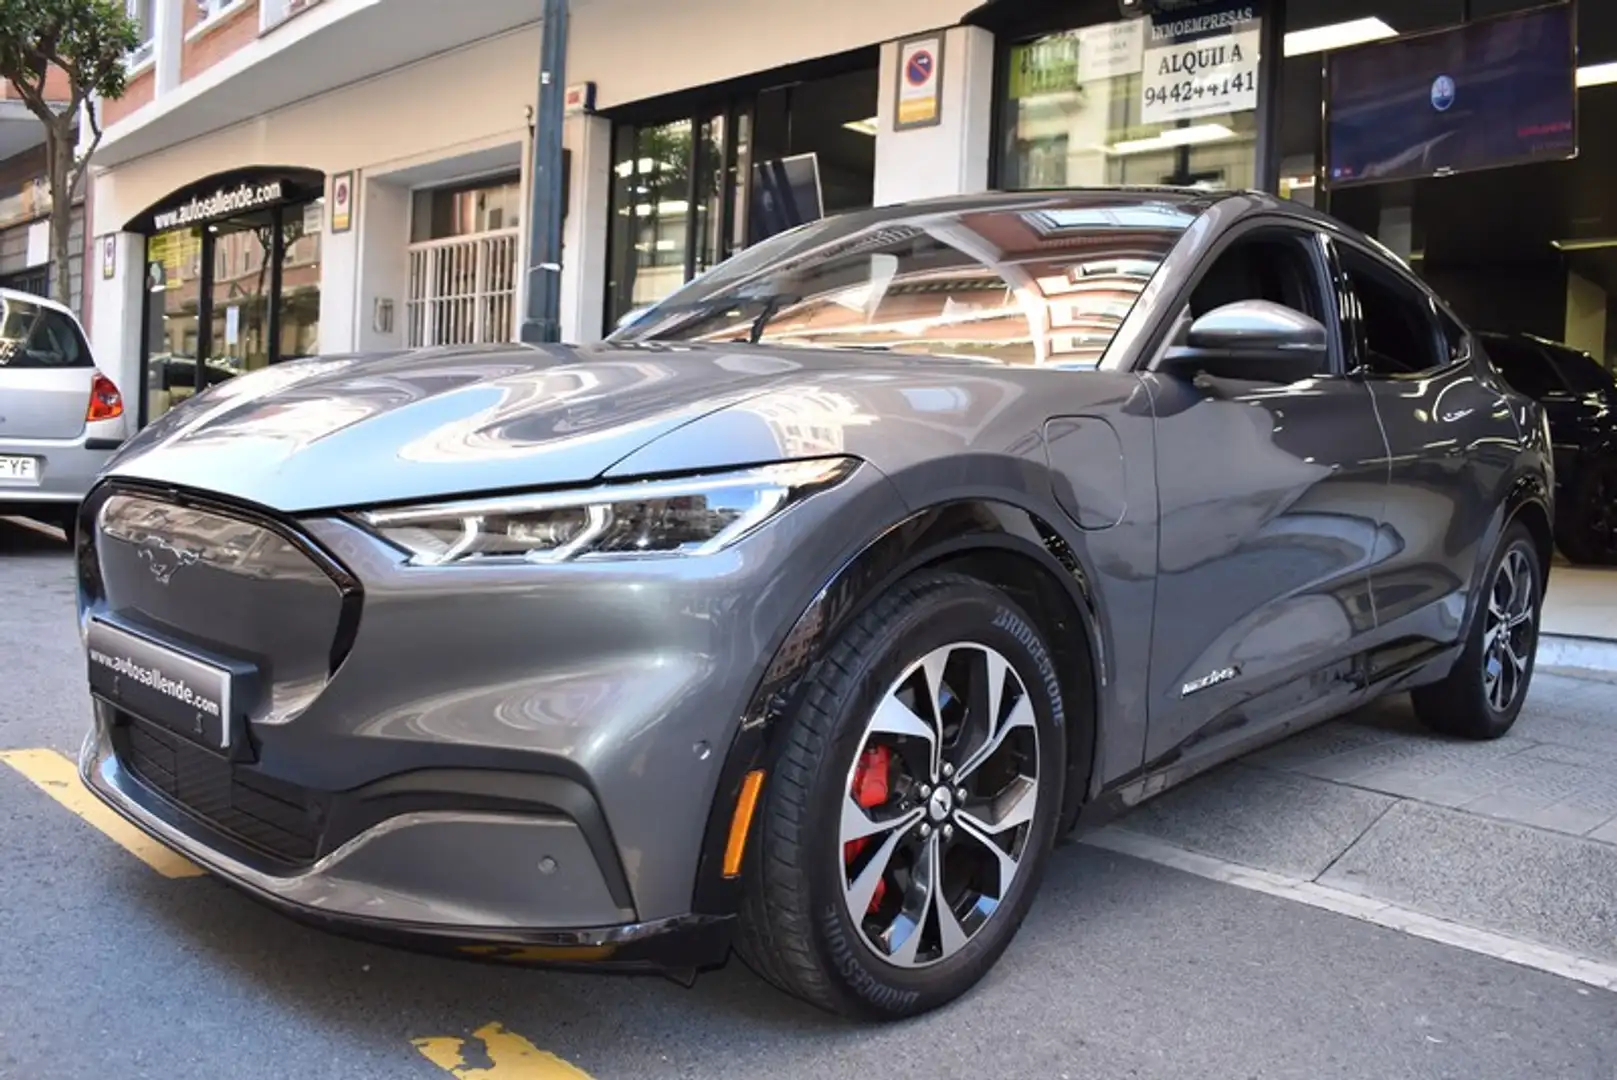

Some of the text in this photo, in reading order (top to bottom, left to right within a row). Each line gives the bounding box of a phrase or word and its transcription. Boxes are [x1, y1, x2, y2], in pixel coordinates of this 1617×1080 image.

[1158, 42, 1243, 76] ALQUILA
[153, 182, 281, 230] www.autosallende.com
[90, 649, 220, 717] www.autosallende.com
[991, 604, 1065, 727] BRIDGESTONE
